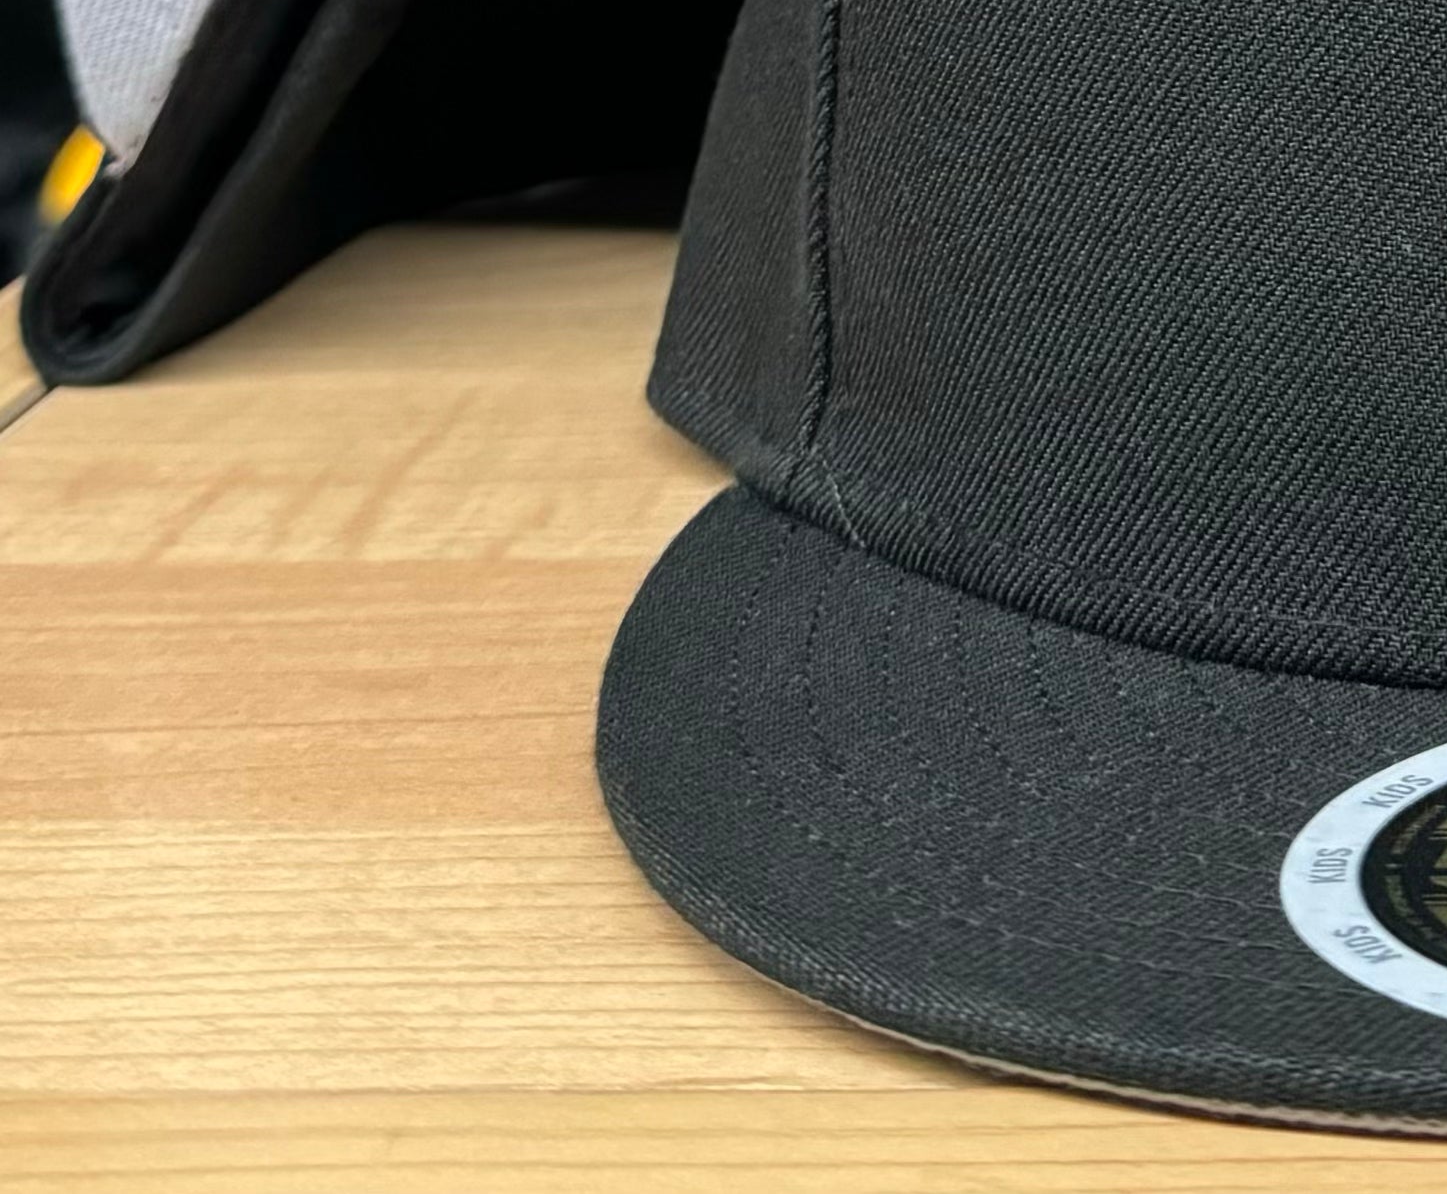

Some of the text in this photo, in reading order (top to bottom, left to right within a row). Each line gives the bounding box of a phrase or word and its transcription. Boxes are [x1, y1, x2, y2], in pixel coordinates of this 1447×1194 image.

[1362, 773, 1434, 809] KIDS
[1307, 847, 1353, 884] KIDS
[1332, 925, 1403, 964] KIDS
